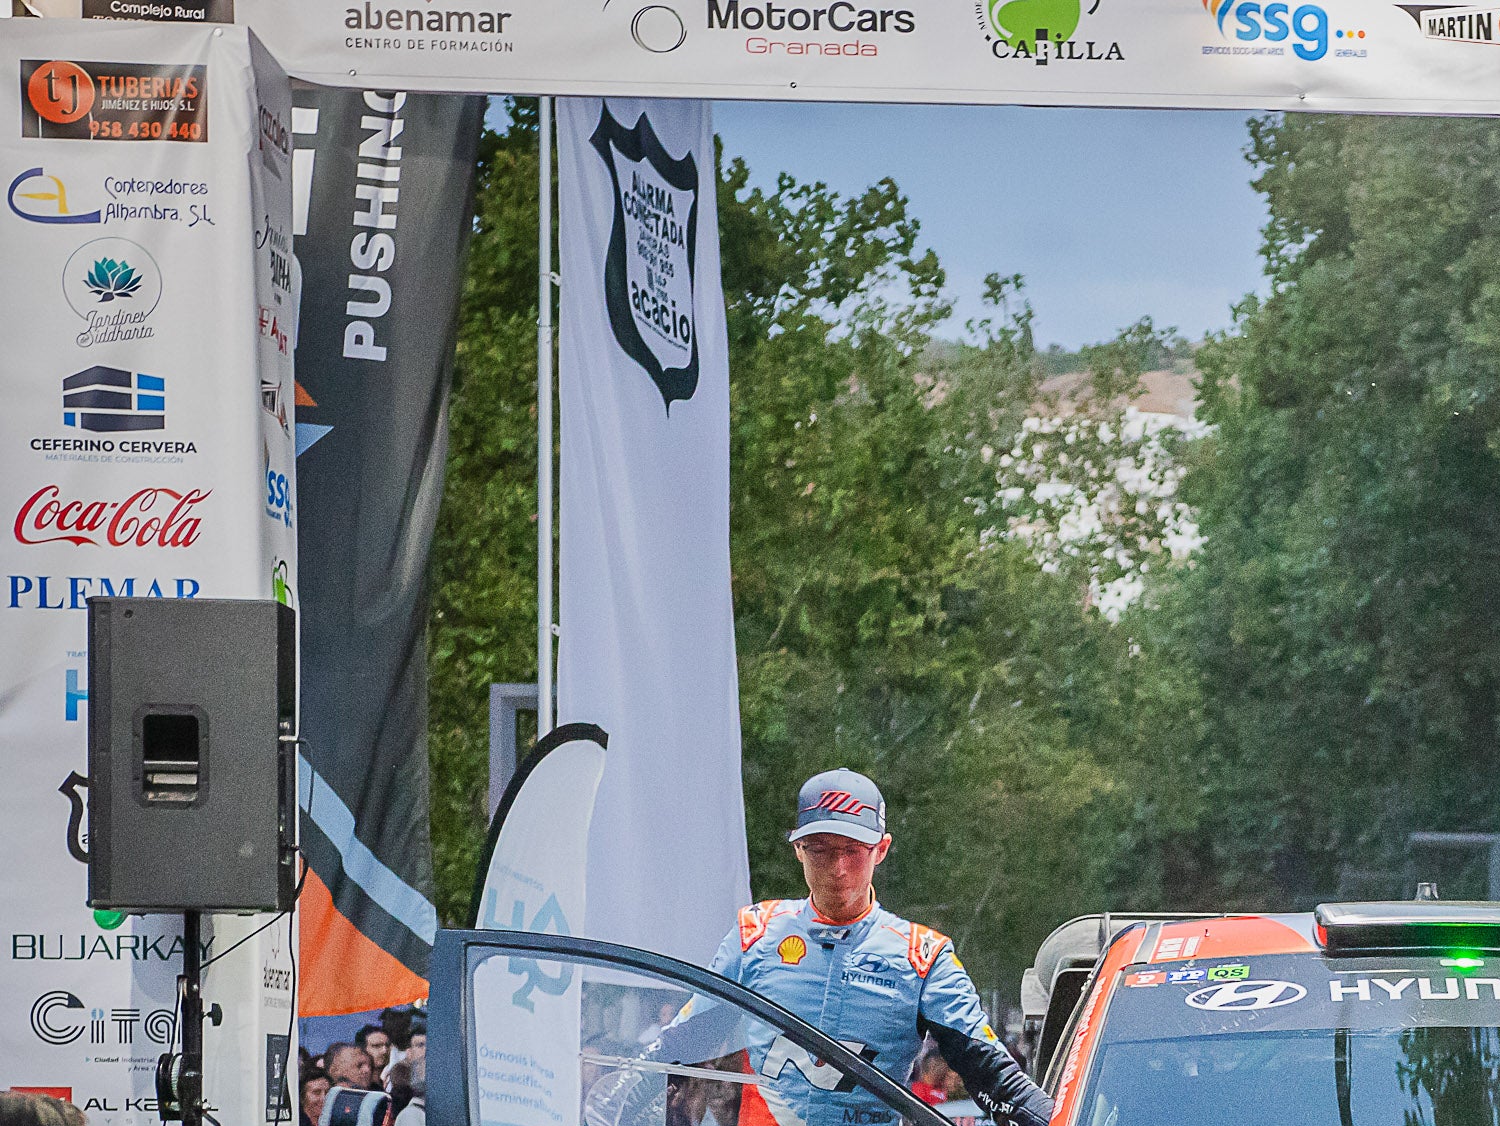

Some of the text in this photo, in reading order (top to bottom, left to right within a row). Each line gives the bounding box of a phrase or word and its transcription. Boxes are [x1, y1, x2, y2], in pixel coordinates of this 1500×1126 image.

[110, 1, 172, 19] Complejo
[175, 5, 205, 20] Rural
[344, 1, 512, 34] abenamar
[707, 1, 915, 33] MotorCars
[1235, 2, 1328, 61] ssg
[1428, 12, 1492, 40] MARTIN
[345, 38, 514, 52] CENTRO DE FORMACIÓN
[746, 37, 878, 57] Granada
[97, 75, 198, 99] TUBERIAS
[101, 99, 140, 111] JIMÉNEZ
[142, 101, 149, 111] E
[89, 121, 201, 140] 958 430 440
[104, 176, 208, 199] Contenedores
[86, 309, 147, 333] Jardines
[631, 280, 691, 345] acacio
[30, 438, 197, 453] CEFERINO CERVERA
[45, 454, 99, 463] MATERIALES
[100, 455, 113, 463] DE
[14, 484, 214, 547] Coca-Cola
[7, 575, 201, 610] PLEMAR
[841, 970, 898, 990] HYUNDAI
[1214, 968, 1244, 979] QS
[84, 1098, 118, 1111] AL
[842, 1107, 895, 1125] MOBIS
